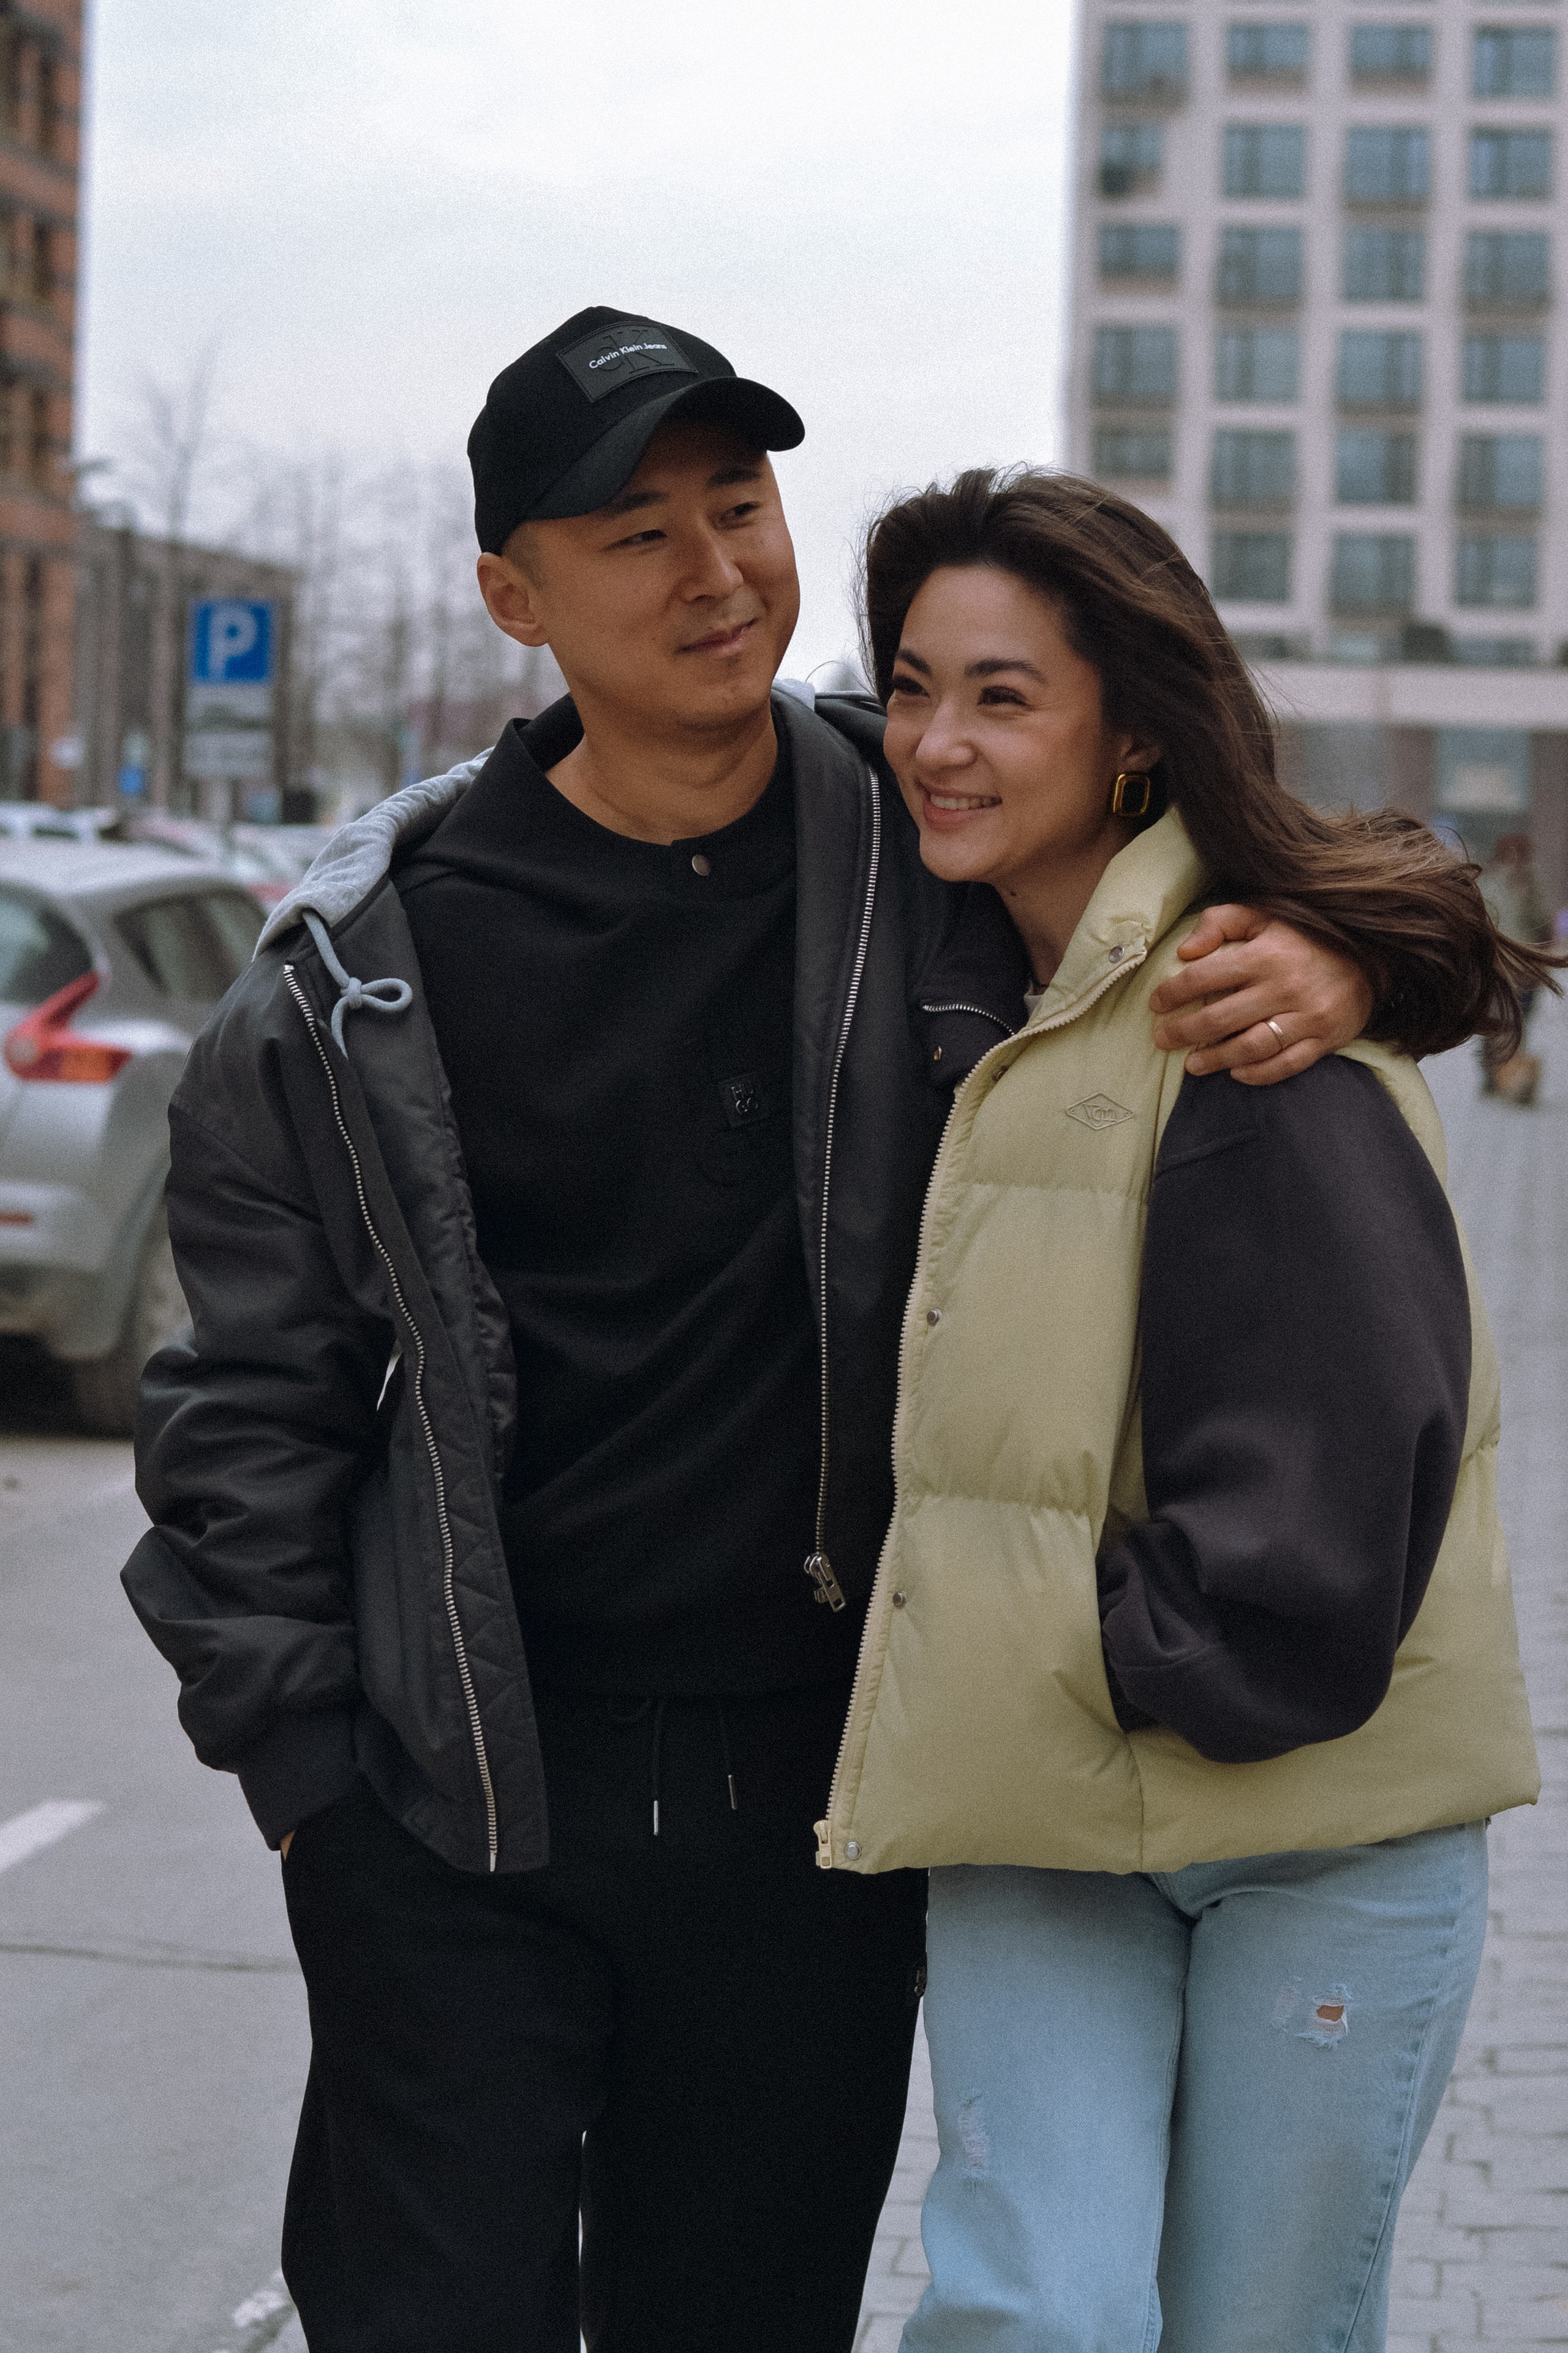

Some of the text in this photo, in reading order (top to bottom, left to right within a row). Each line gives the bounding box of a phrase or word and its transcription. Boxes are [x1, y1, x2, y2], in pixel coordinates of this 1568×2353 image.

[589, 350, 620, 369] Calvin
[619, 344, 644, 355] Klein
[209, 605, 258, 679] P
